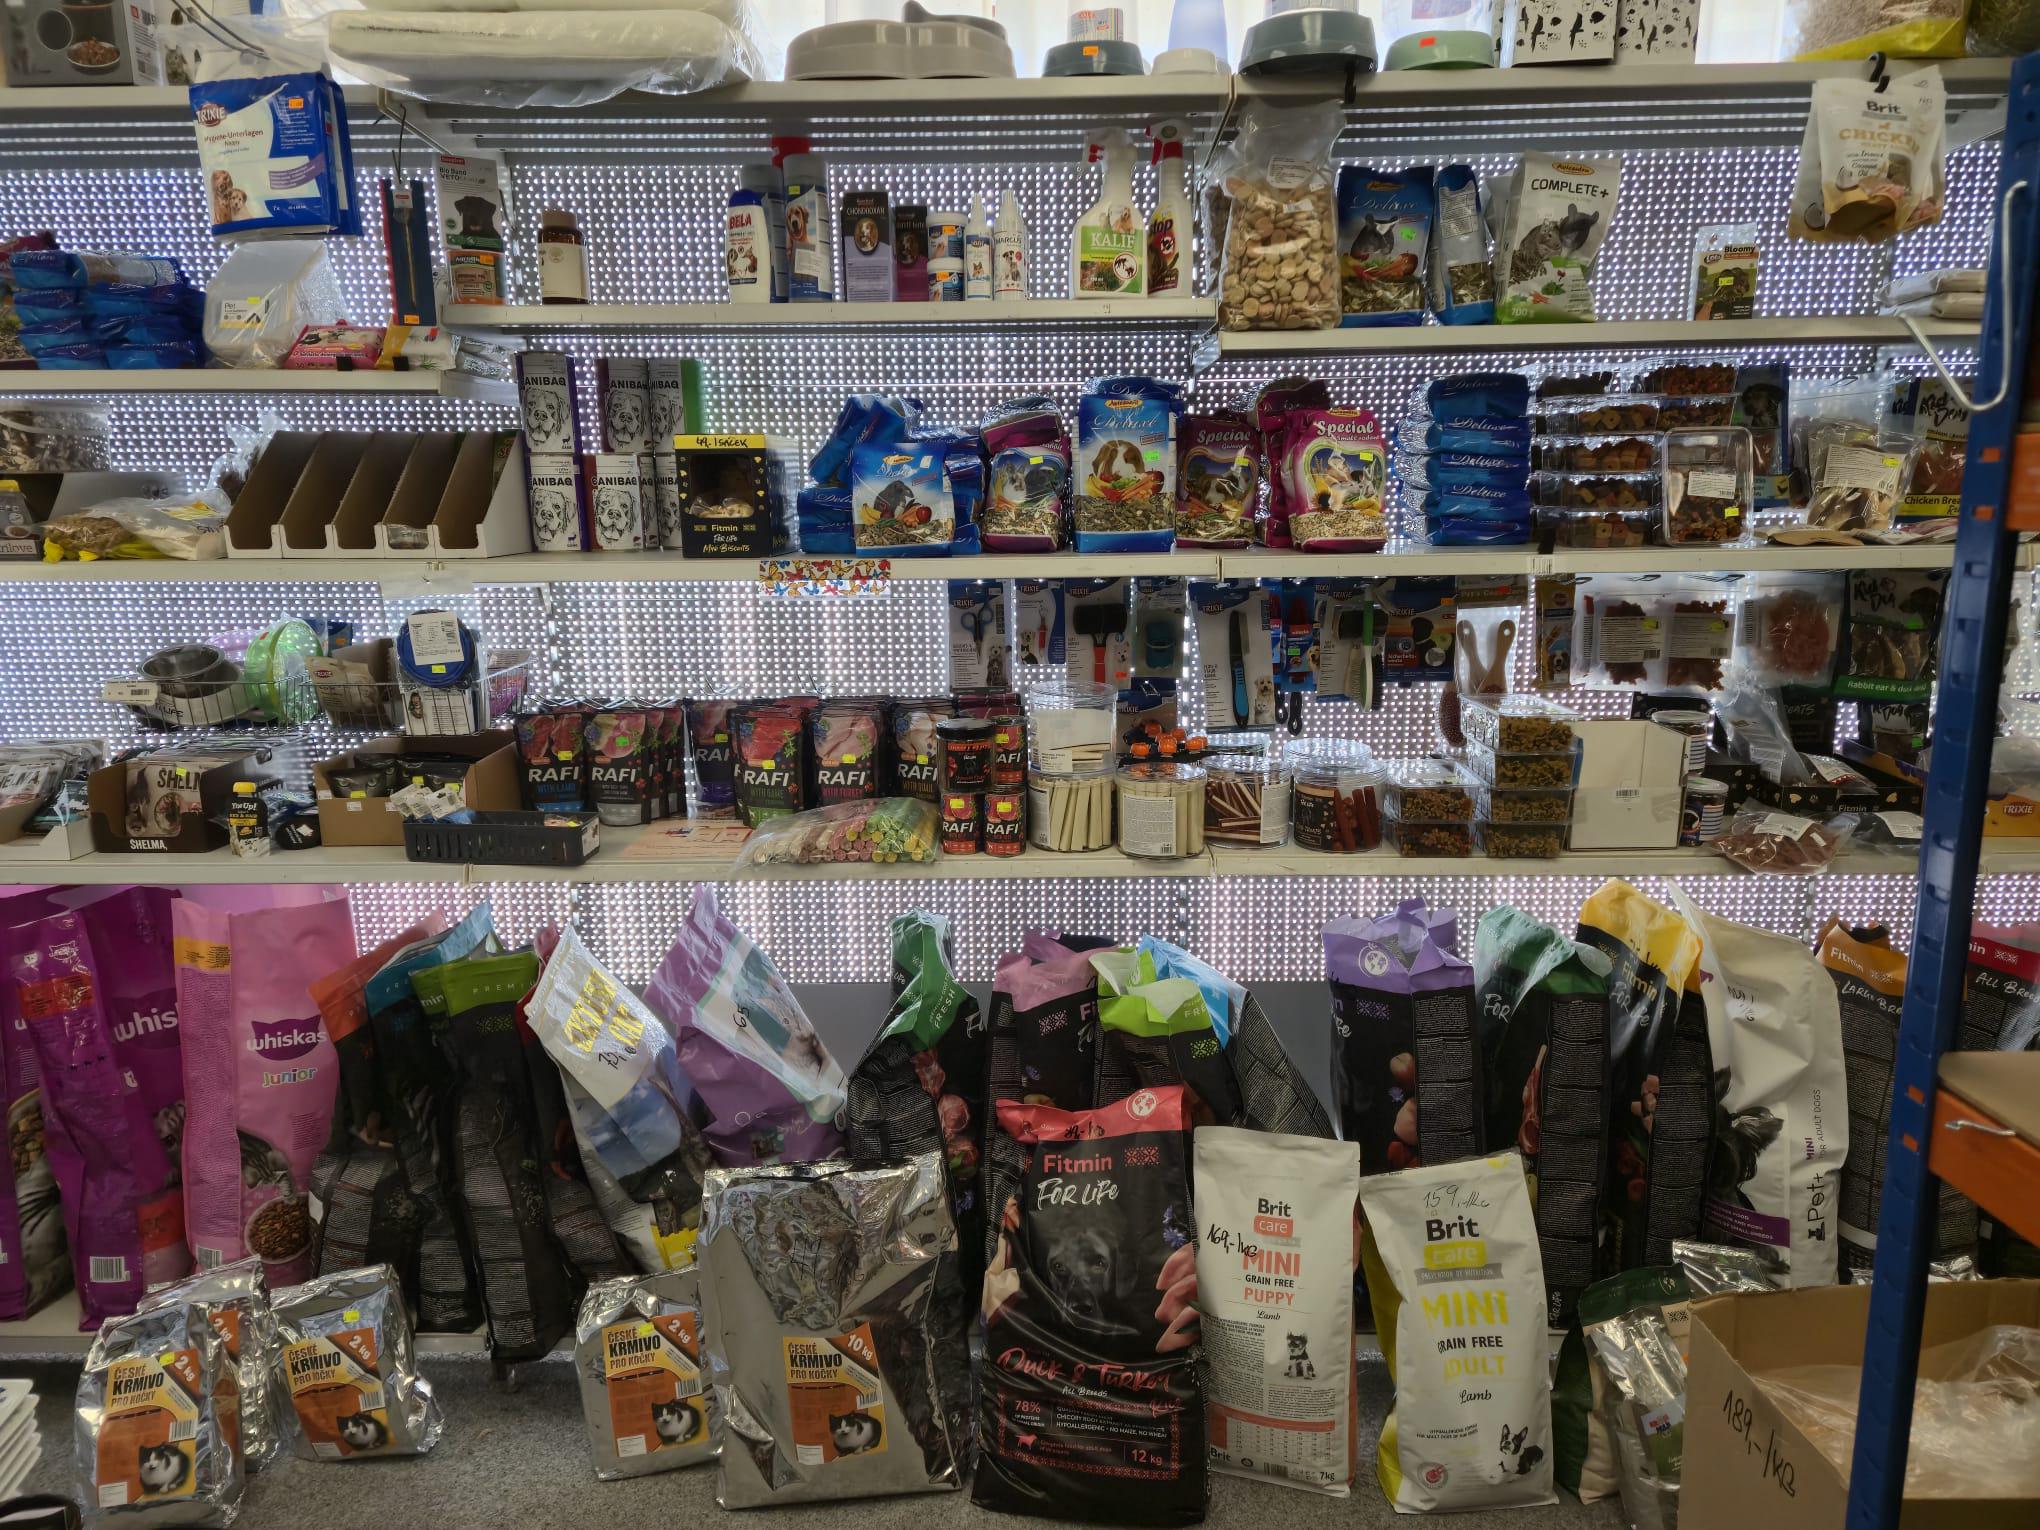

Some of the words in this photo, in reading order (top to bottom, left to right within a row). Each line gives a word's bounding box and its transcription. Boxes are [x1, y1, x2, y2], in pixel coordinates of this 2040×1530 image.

[196, 107, 226, 123] TRIXIE
[1866, 101, 1901, 114] Brit
[729, 213, 752, 230] BELA
[1091, 232, 1136, 249] KALIF
[1724, 244, 1756, 255] Bloomy
[1316, 420, 1374, 437] Special
[1904, 496, 1940, 505] Chicken
[711, 524, 738, 532] Fitmin
[953, 599, 974, 608] TRIXIE
[1202, 604, 1225, 613] TRIXIE
[1847, 680, 1875, 691] Rabbit
[528, 766, 579, 782] RAFI
[591, 767, 637, 783] RAFI
[743, 770, 789, 787] RAFI
[818, 770, 866, 786] RAFI
[1838, 804, 1867, 813] Fitmin
[2002, 803, 2033, 815] TRIXIE
[943, 821, 973, 833] RAFI
[986, 823, 1018, 835] RAFI
[1621, 960, 1658, 1002] Fitmin
[934, 988, 956, 1029] FRESH
[247, 1028, 327, 1053] whiskas
[1813, 1089, 1821, 1113] DOGS
[1805, 1137, 1815, 1161] MINI
[1044, 1153, 1113, 1173] Fitmin
[1258, 1198, 1292, 1217] Brit
[1259, 1221, 1288, 1234] care
[1425, 1216, 1480, 1241] Brit
[1242, 1248, 1300, 1277] MINI
[1433, 1247, 1479, 1265] care
[1245, 1274, 1271, 1286] GRAIN
[1274, 1278, 1295, 1289] FREE
[1244, 1287, 1295, 1306] PUPPY
[1256, 1309, 1281, 1320] Lamb
[1421, 1288, 1510, 1329] MINI
[608, 1326, 638, 1343] ČESKÉ
[668, 1320, 680, 1333] 2
[679, 1331, 691, 1344] kg
[349, 1336, 362, 1348] 2
[360, 1347, 371, 1360] kg
[609, 1335, 661, 1358] KRMIVO
[788, 1342, 817, 1354] ČESKÉ
[847, 1334, 863, 1351] 10
[861, 1349, 873, 1361] kg
[1472, 1336, 1503, 1348] FREE
[289, 1344, 318, 1362] ČESKÉ
[610, 1357, 626, 1369] PRO
[628, 1352, 656, 1367] KOČKY
[789, 1353, 842, 1368] KRMIVO
[175, 1356, 186, 1369] 2
[185, 1369, 195, 1382] kg
[291, 1351, 341, 1376] KRMIVO
[115, 1366, 146, 1379] ČESKÉ
[294, 1374, 311, 1386] PRO
[790, 1369, 807, 1379] PRO
[809, 1367, 839, 1379] KOČKY
[113, 1373, 164, 1395] KRMIVO
[112, 1394, 129, 1407] PRO
[131, 1390, 156, 1405] KOČKY
[1459, 1389, 1492, 1404] Lamb
[1015, 1400, 1041, 1413] 78%
[1131, 1449, 1147, 1463] 12
[1150, 1455, 1163, 1466] kg
[1210, 1448, 1231, 1462] Brit
